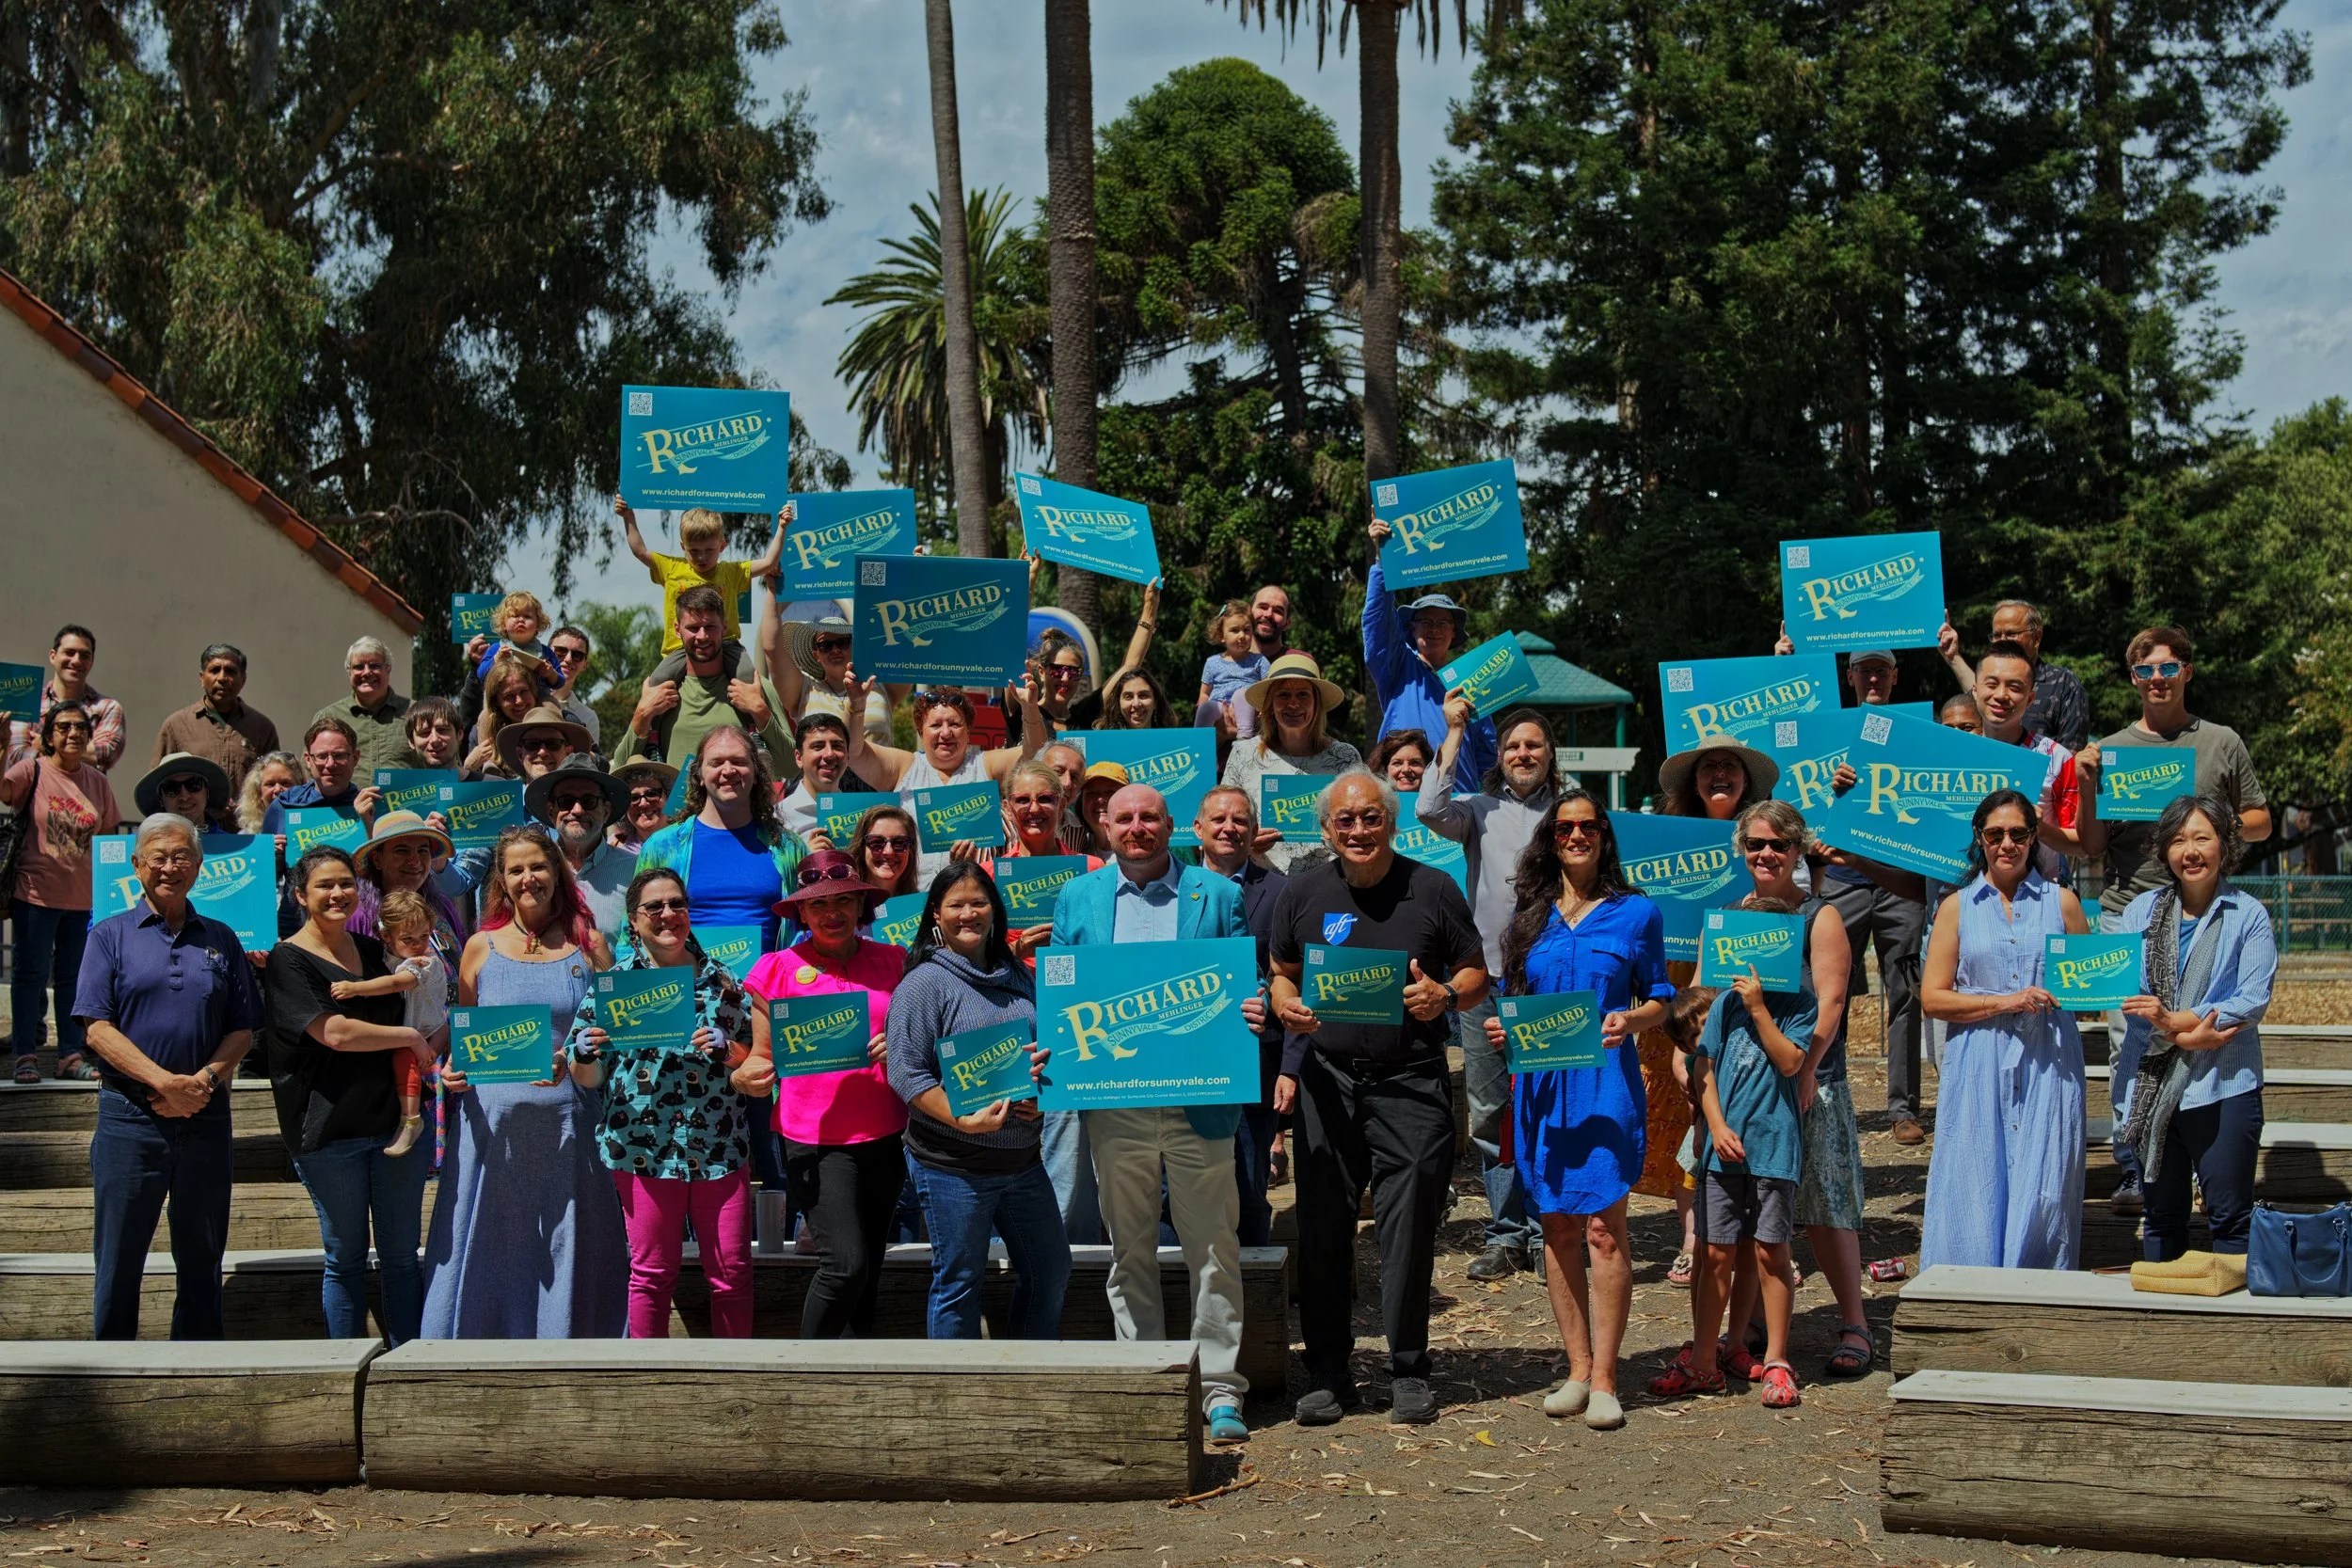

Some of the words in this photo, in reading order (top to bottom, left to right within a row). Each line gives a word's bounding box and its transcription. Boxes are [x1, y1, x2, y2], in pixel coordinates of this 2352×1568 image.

[640, 415, 762, 475] RICHARD
[714, 436, 748, 448] MEHLINGER
[643, 488, 765, 499] www.richardforsunnyvale.com
[1036, 505, 1130, 543] RICHARD
[1392, 485, 1494, 556] RICHARD
[1455, 506, 1485, 521] MEHLINGER
[789, 512, 893, 570] RICHARD
[1044, 545, 1144, 574] www.richardforsunnyvale.com
[1402, 554, 1508, 575] www.richardforsunnyvale.com
[795, 580, 854, 589] www.richardfors
[1801, 557, 1915, 621] RICHARD
[1870, 578, 1904, 591] MEHLINGER
[459, 608, 495, 629] RICHA
[873, 585, 1001, 647] RICHARD
[950, 608, 986, 619] MEHLINGER
[1806, 628, 1925, 641] www.richardforsunnyvale.com
[875, 661, 1003, 673] www.richardforsunnyvale.com
[1458, 649, 1508, 702] RICHARD
[1684, 680, 1810, 747] RICHARD
[1762, 703, 1798, 718] MEHLINGER
[1129, 752, 1190, 783] HARD
[2107, 763, 2180, 800] RICHARD
[384, 784, 437, 812] RICHAR
[1272, 793, 1317, 823] RICHA
[1867, 763, 2009, 824] RICHARD
[1897, 799, 1943, 810] SUNNYVALE
[446, 794, 511, 831] RICHARD
[926, 796, 987, 834] RICHARD
[294, 819, 355, 850] RICHARD
[1851, 827, 1973, 870] www.richardforsunnyvale.c
[1626, 849, 1728, 884] ICHARD
[1671, 873, 1710, 886] MEHLINGER
[1006, 871, 1073, 909] RICHARD
[1692, 880, 1721, 898] DISTRICT
[1325, 913, 1359, 941] aft
[706, 941, 747, 958] HARD
[1714, 930, 1788, 966] RICHARD
[1314, 966, 1391, 1001] RICHARD
[2056, 949, 2128, 989] RICHARD
[606, 984, 678, 1027] RICHARD
[1062, 972, 1220, 1062] RICHARD
[1158, 1002, 1203, 1021] MEHLINGER
[1184, 1007, 1215, 1031] DISTRICT
[462, 1021, 535, 1062] RICHARD
[781, 1008, 854, 1053] RICHARD
[1107, 1023, 1158, 1046] SUNNYVALE
[1511, 1007, 1584, 1051] RICHARD
[951, 1037, 1017, 1091] RICHARD
[1067, 1076, 1230, 1091] www.richardforsunnyvale.com
